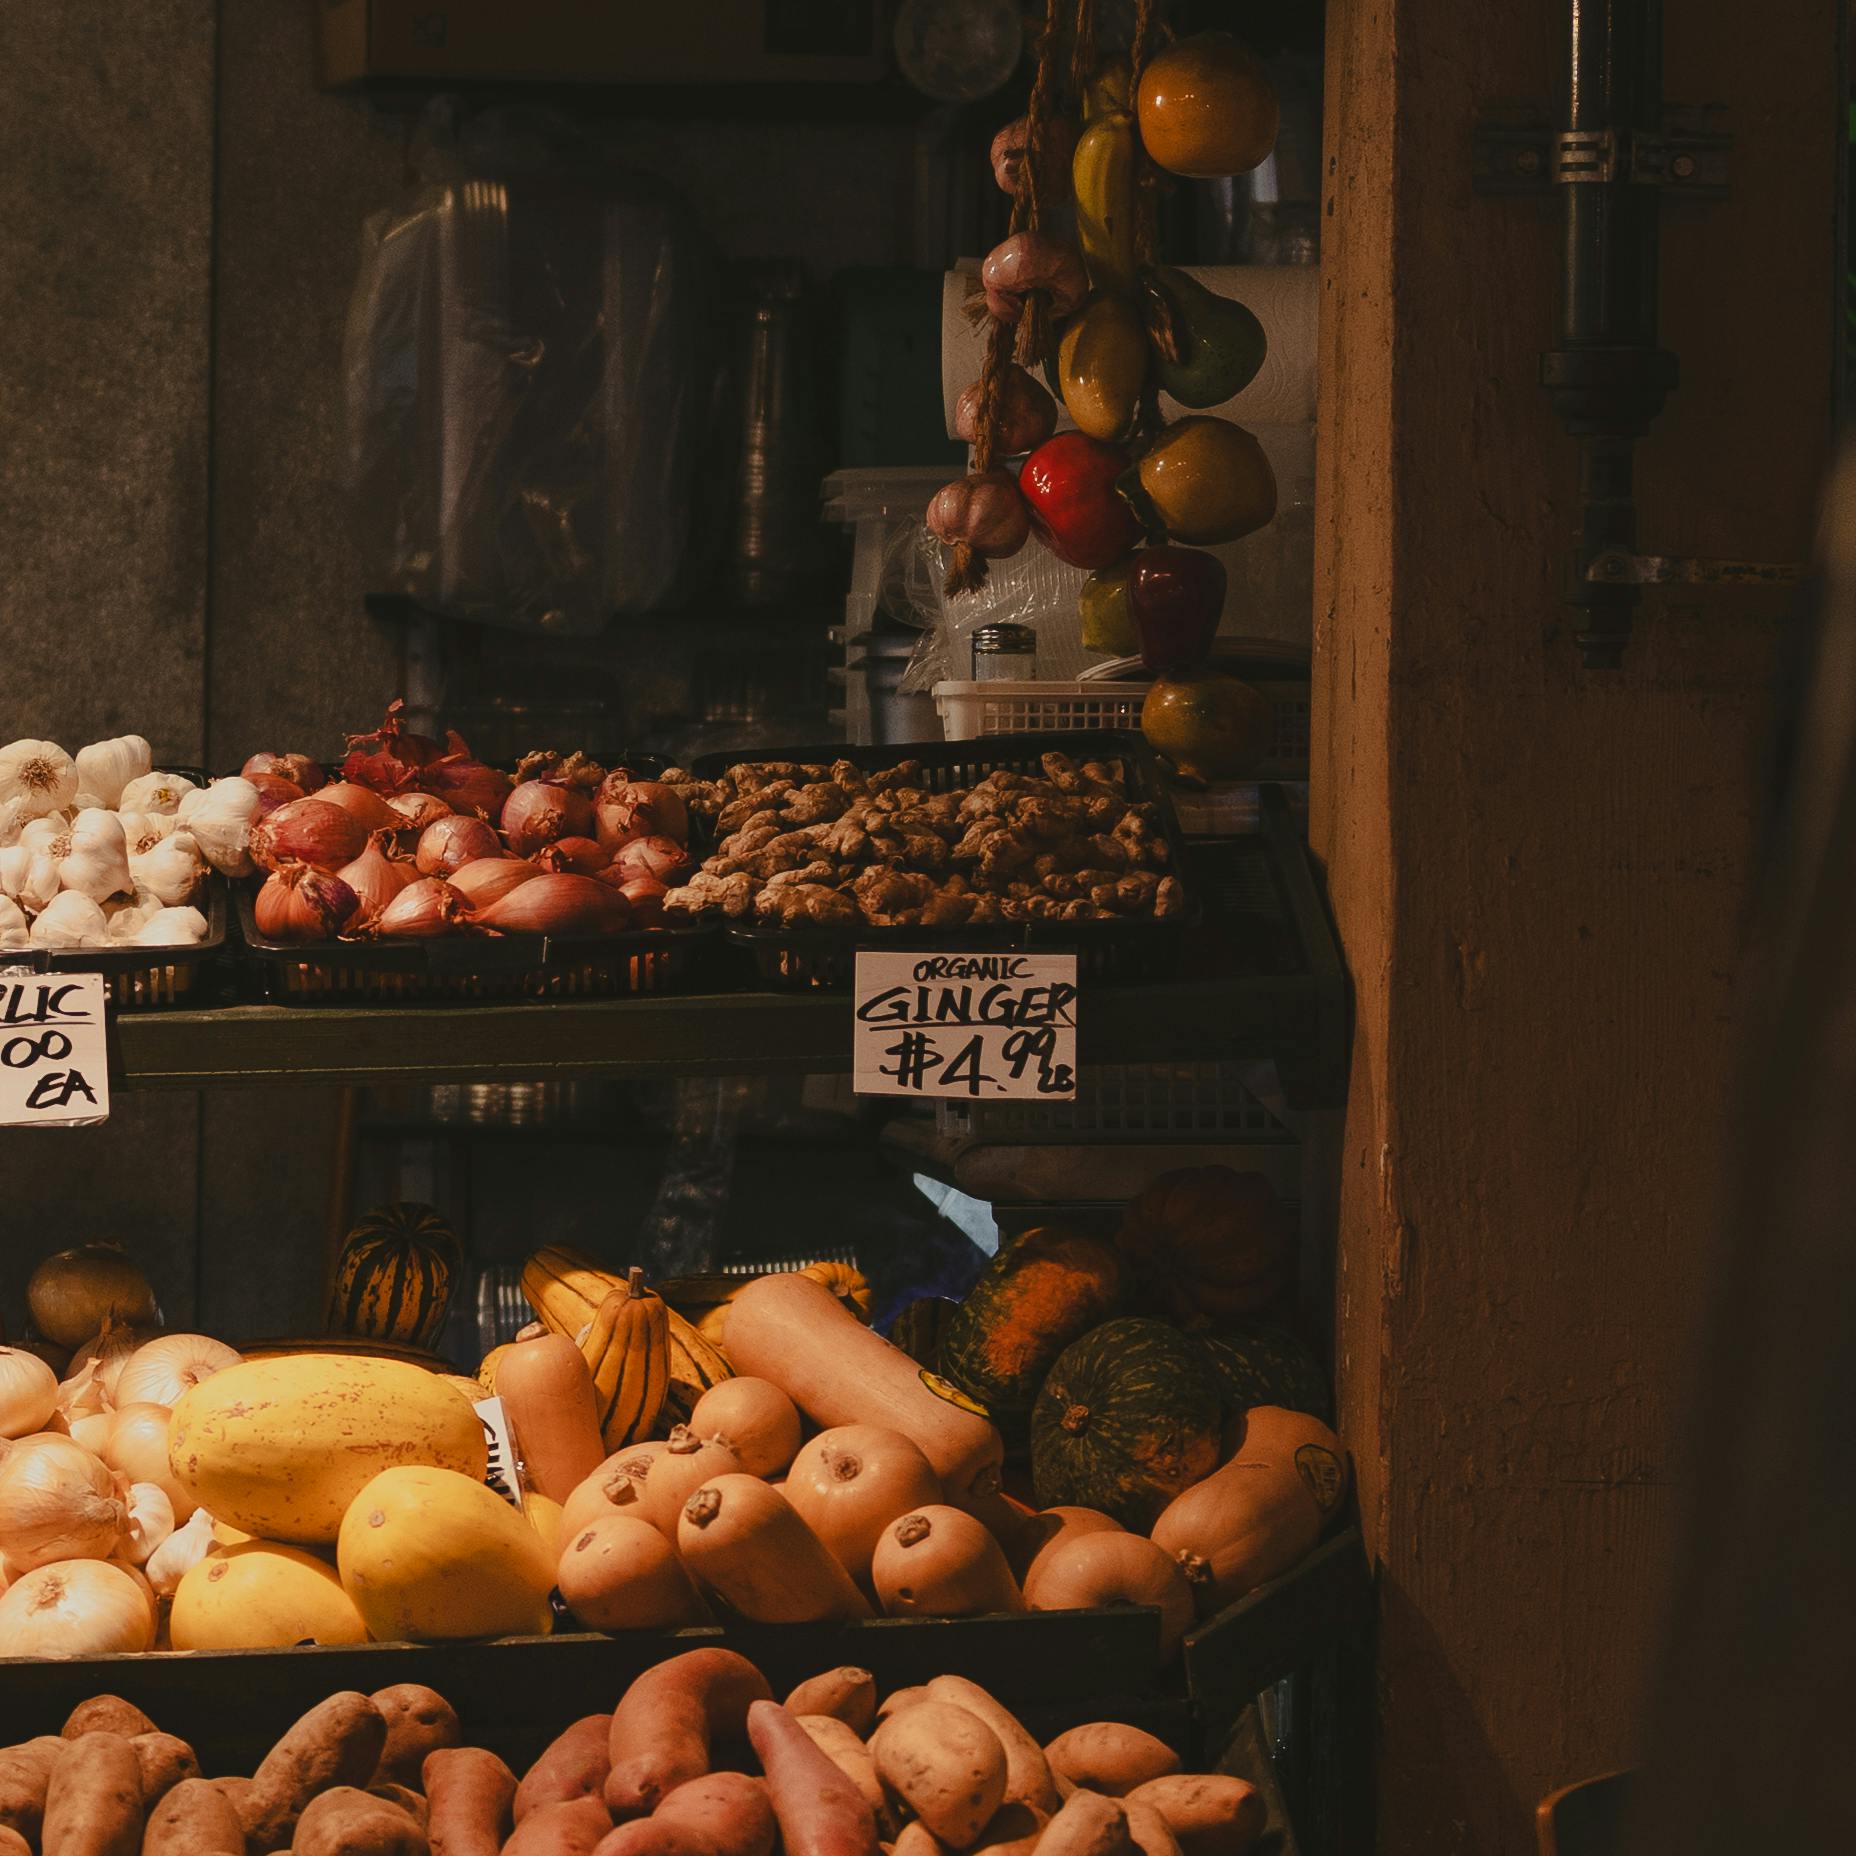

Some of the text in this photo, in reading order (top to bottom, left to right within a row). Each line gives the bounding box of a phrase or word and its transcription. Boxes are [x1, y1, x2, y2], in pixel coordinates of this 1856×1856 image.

[913, 957, 1034, 982] ORGANIC
[857, 983, 1076, 1030] GINGER
[879, 1024, 1057, 1096] $4.99
[26, 1069, 98, 1109] EA
